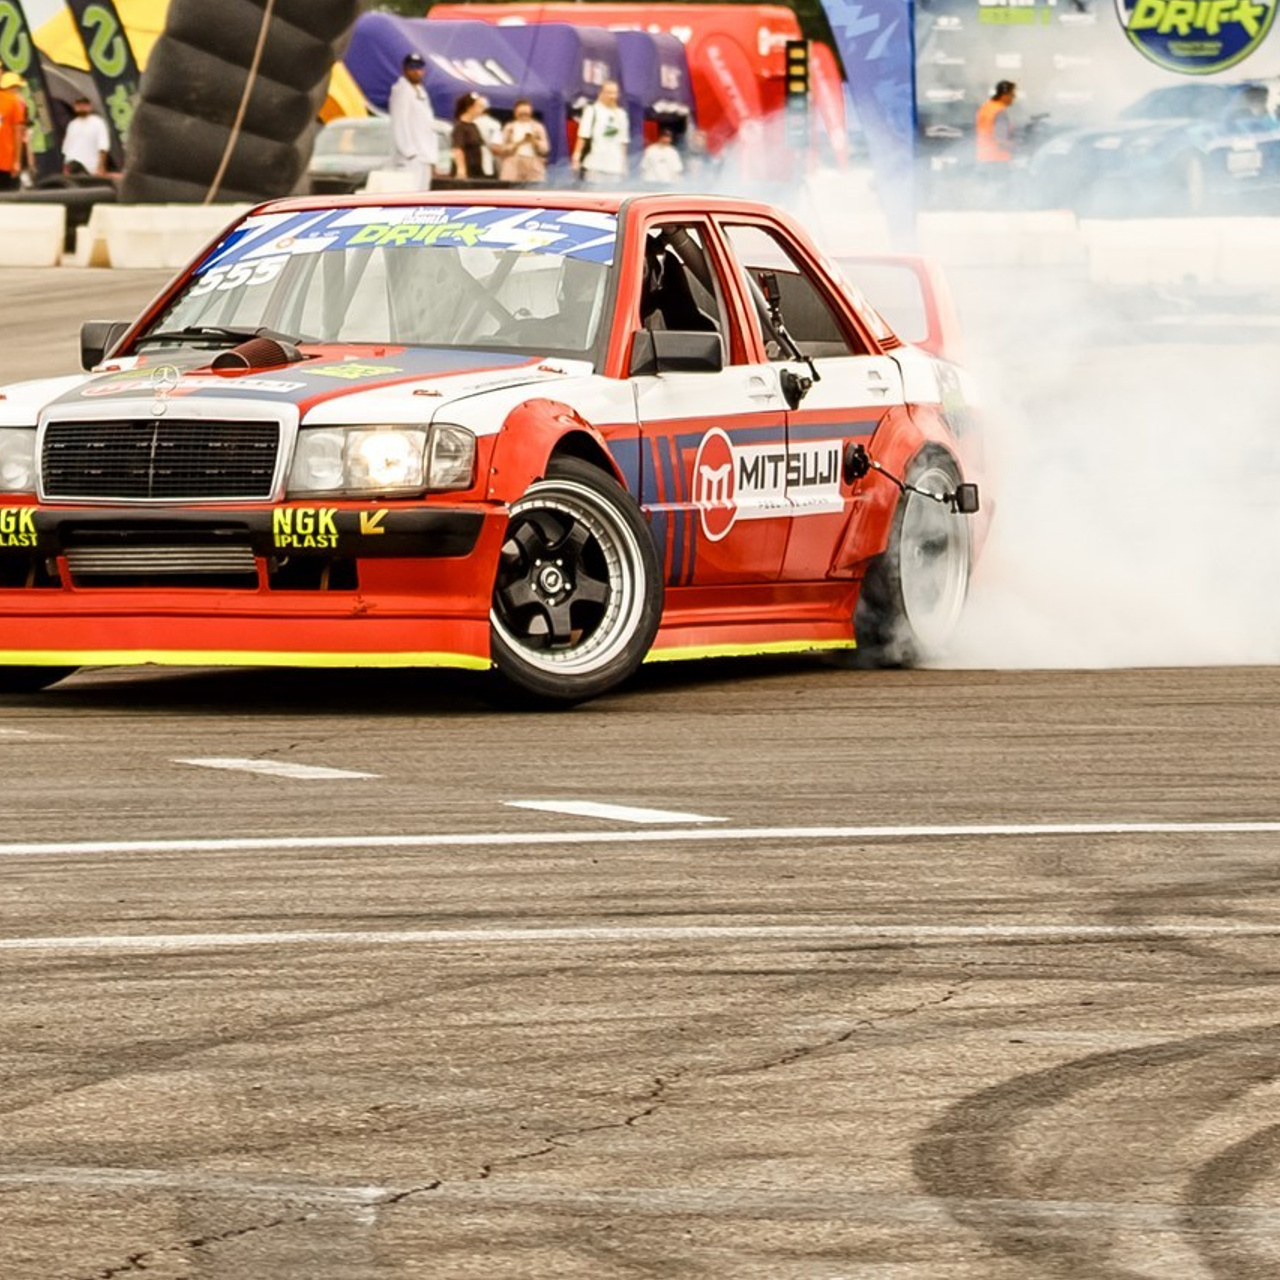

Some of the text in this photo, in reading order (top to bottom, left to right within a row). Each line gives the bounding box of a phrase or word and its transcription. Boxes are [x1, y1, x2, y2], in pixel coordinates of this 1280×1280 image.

[346, 222, 488, 246] DRIFT
[190, 254, 291, 297] 555
[738, 449, 839, 491] MITSUJI
[273, 507, 338, 535] NGK
